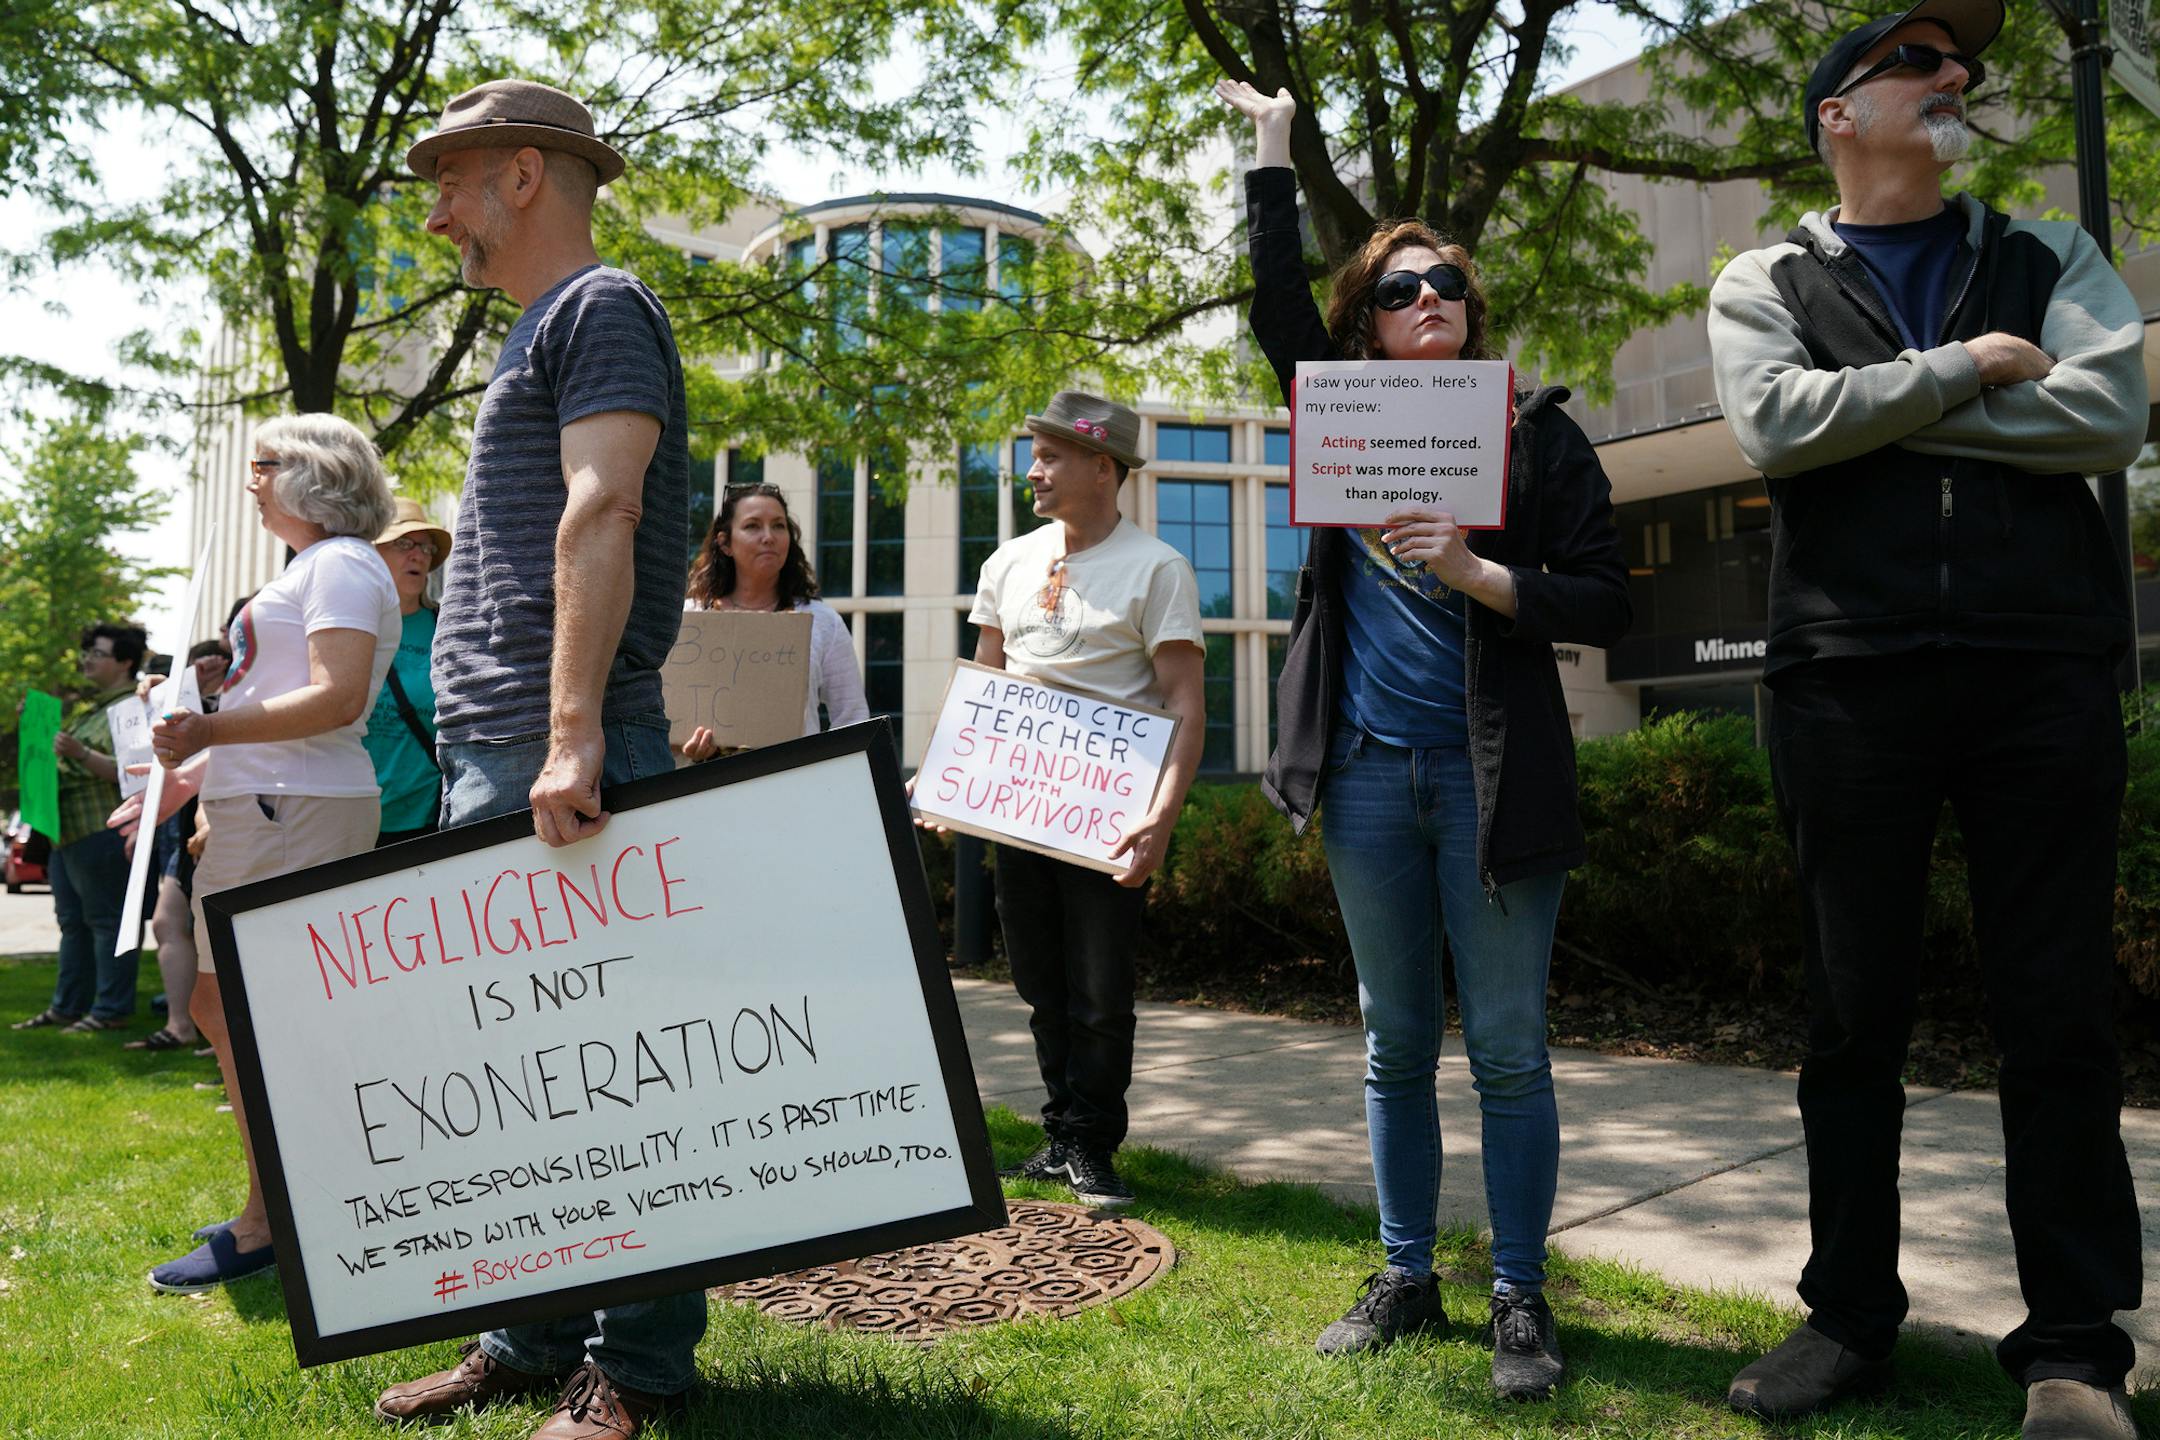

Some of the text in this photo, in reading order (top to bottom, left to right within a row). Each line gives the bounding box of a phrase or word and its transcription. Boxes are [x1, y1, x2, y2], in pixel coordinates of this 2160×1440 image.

[1305, 375, 1477, 391] I saw your video. Here's
[1305, 400, 1382, 415] my review:
[1311, 462, 1478, 478] Script was more excuse
[1321, 436, 1482, 451] Acting seemed forced.
[1345, 487, 1443, 504] than apology.
[669, 625, 797, 684] Boycott
[1553, 648, 1581, 667] any
[964, 700, 1129, 763] TEACHER
[982, 680, 1150, 738] A PROUD CTC
[953, 727, 1134, 797] STANDING
[1010, 775, 1062, 797] WITH
[937, 766, 1126, 846] SURVIVORS
[307, 836, 703, 1000] NEGLIGENCE
[468, 955, 634, 1030] IS NOT
[354, 995, 817, 1165] EXONERATION
[344, 1185, 421, 1230] TAKE
[711, 1117, 739, 1148] IT
[746, 1112, 773, 1140] IS
[781, 1096, 848, 1135] PAST
[849, 1083, 926, 1118] TIME.
[337, 1245, 387, 1277] WE
[393, 1227, 473, 1258] STAND
[484, 1211, 546, 1244] WITH
[551, 1199, 616, 1231] YOUR
[627, 1175, 743, 1216] VICTIMS.
[749, 1161, 797, 1190] YOU
